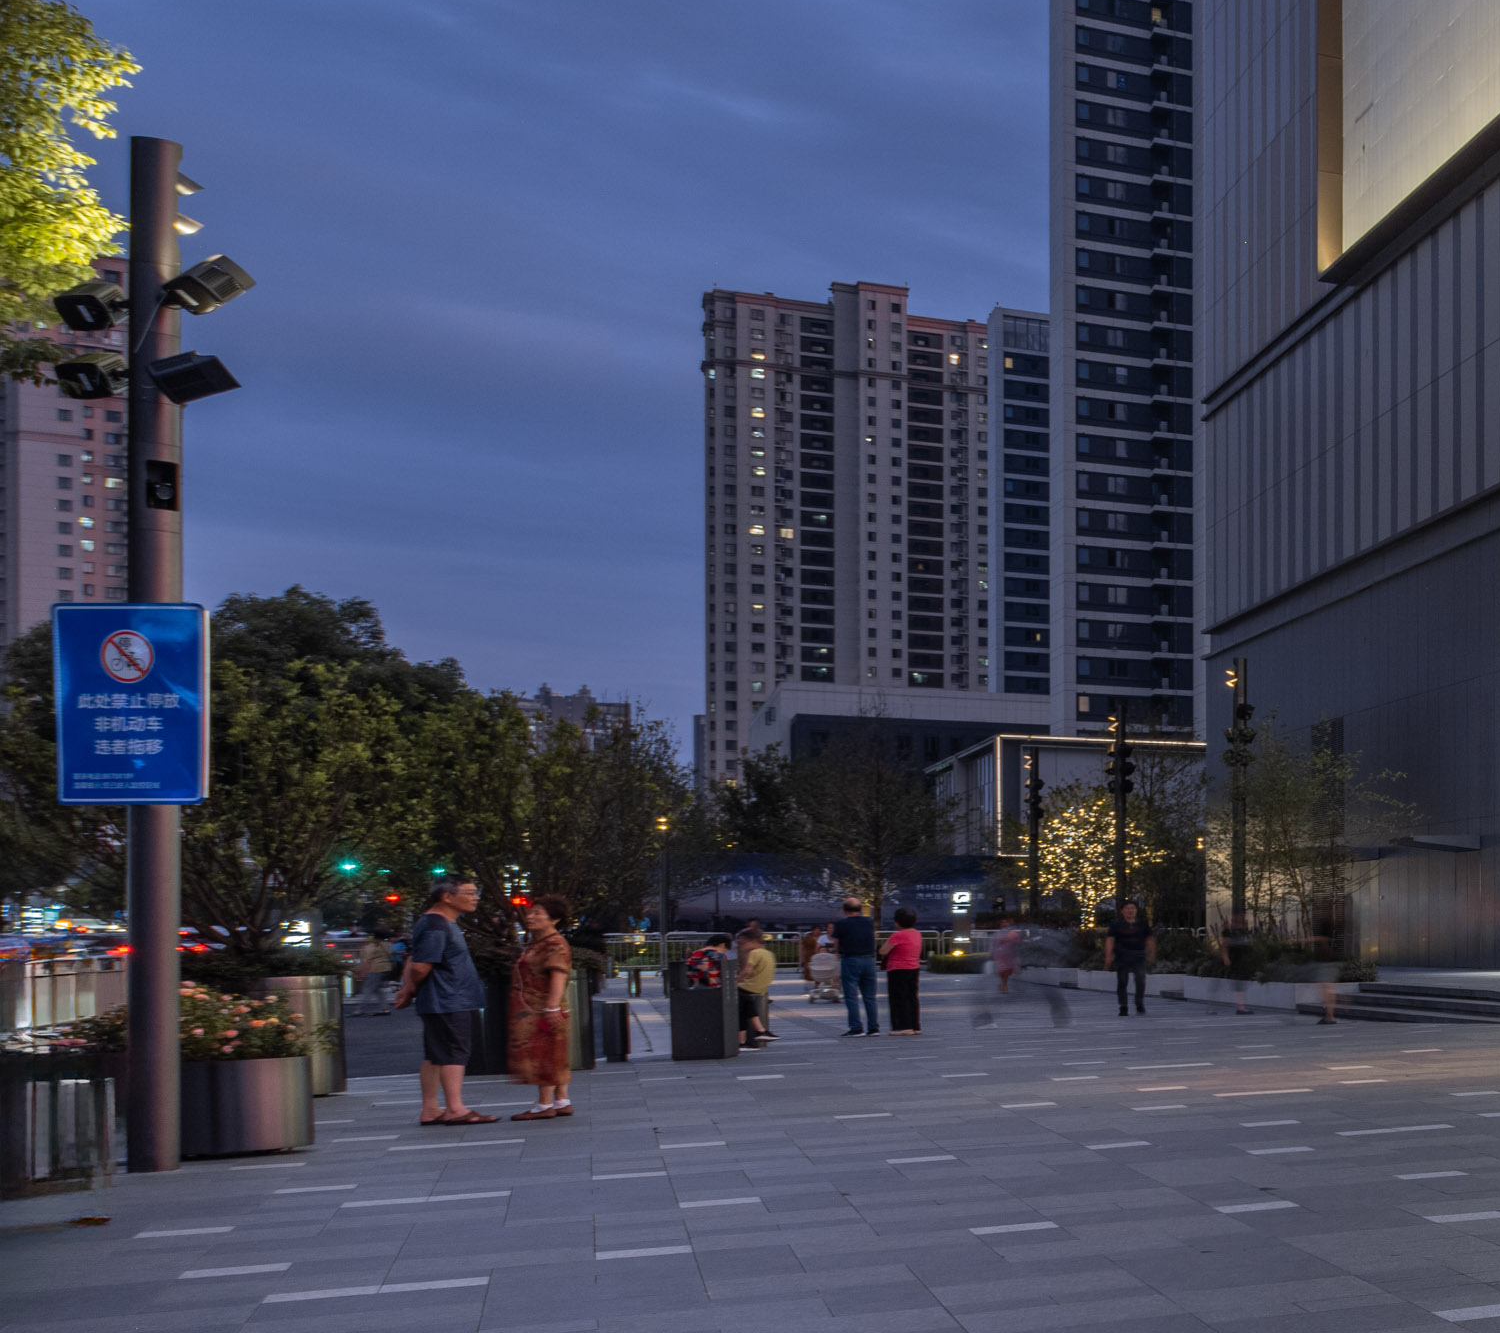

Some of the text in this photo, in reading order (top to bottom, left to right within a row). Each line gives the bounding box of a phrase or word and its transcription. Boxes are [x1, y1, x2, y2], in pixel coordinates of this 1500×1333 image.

[76, 692, 181, 709] 此处禁止停放
[93, 715, 164, 732] 非机动车
[93, 738, 165, 755] 违者拖移
